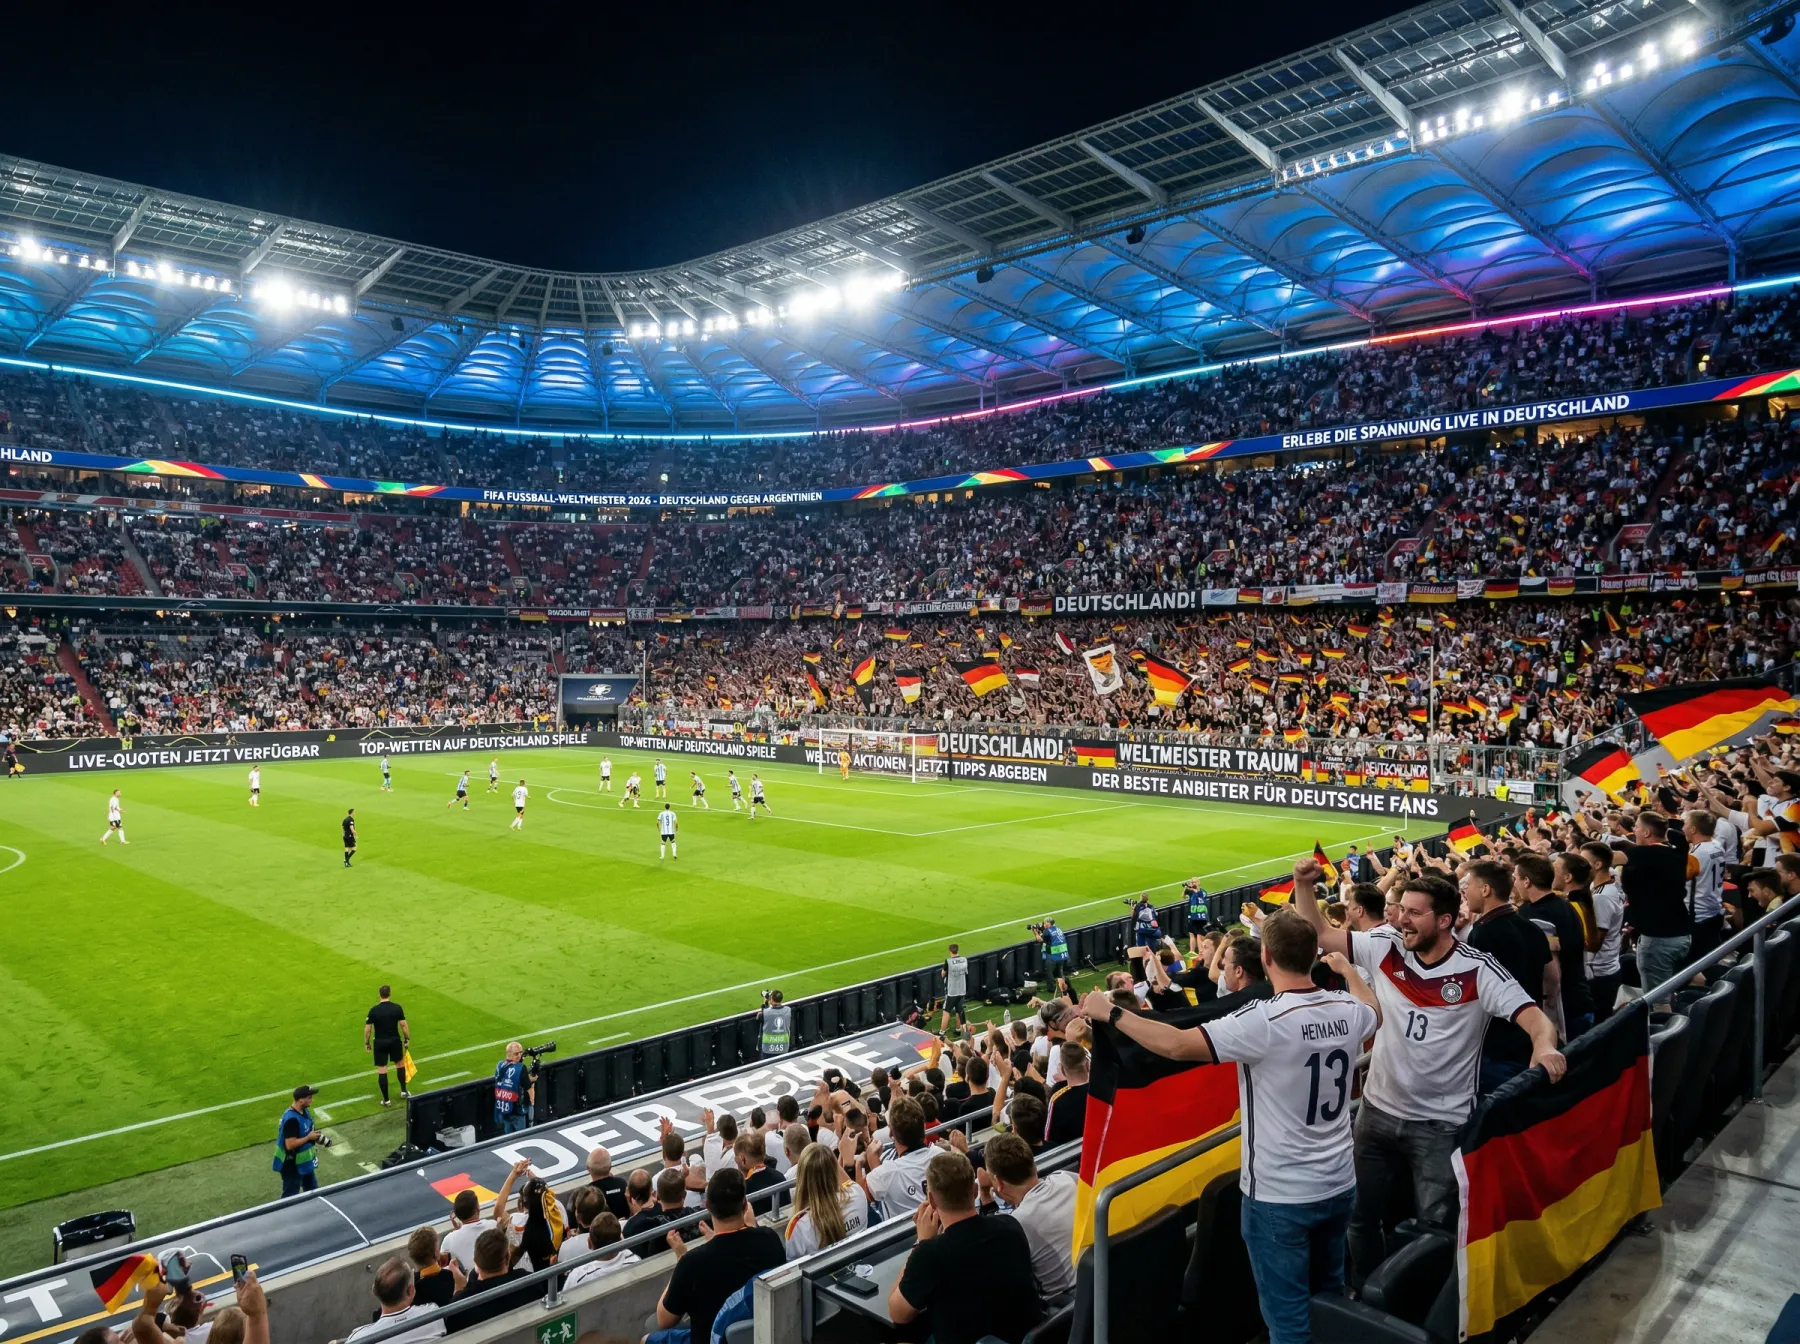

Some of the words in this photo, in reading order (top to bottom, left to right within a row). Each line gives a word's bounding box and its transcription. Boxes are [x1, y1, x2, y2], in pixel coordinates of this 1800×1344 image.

[1282, 431, 1332, 449] ERLEBE
[1334, 428, 1357, 443] DIE
[1360, 417, 1441, 440] SPANNUNG
[1445, 413, 1479, 430] LIVE
[1482, 410, 1500, 425] IN
[1503, 395, 1630, 423] DEUTSCHLAND
[0, 447, 53, 463] HLAND
[483, 490, 506, 502] FIFA
[506, 491, 626, 505] FUSSBALL-WELTMEISTER
[627, 495, 652, 505] 2026
[659, 494, 728, 505] DEUTSCHLAND
[729, 493, 761, 504] GEGEN
[762, 491, 823, 504] ARGENTINIEN
[1055, 590, 1196, 613] DEUTSCHLAND!
[69, 749, 181, 770] LIVE-QUOTEN
[184, 748, 231, 763] JETZT
[233, 743, 320, 761] VERFÜGBAR
[359, 738, 441, 755] TOP-WETTEN
[443, 737, 468, 750] AUF
[470, 734, 550, 750] DEUTSCHLAND
[552, 733, 588, 745] SPIELE
[619, 735, 667, 750] TOP-WETTEN
[667, 739, 684, 751] AUF
[685, 741, 745, 757] DEUTSCHLAND
[746, 745, 777, 759] SPIELE
[939, 732, 1064, 760] DEUTSCHLAND!
[1119, 742, 1232, 769] WELTMEISTER
[1235, 750, 1299, 774] TRAUM
[853, 750, 907, 770] AKTIONEN
[916, 757, 950, 774] JETZT
[952, 760, 985, 777] TIPPS
[988, 763, 1047, 782] ABGEBEN
[1092, 772, 1120, 789] DER
[1124, 775, 1168, 793] BESTE
[1172, 778, 1249, 801] ANBIETER
[1253, 781, 1287, 804] FÜR
[1292, 787, 1384, 812] DEUTSCHE
[1389, 794, 1438, 816] FANS
[1405, 1010, 1429, 1042] 13
[1303, 1048, 1350, 1126] 13
[491, 1103, 704, 1179] DER
